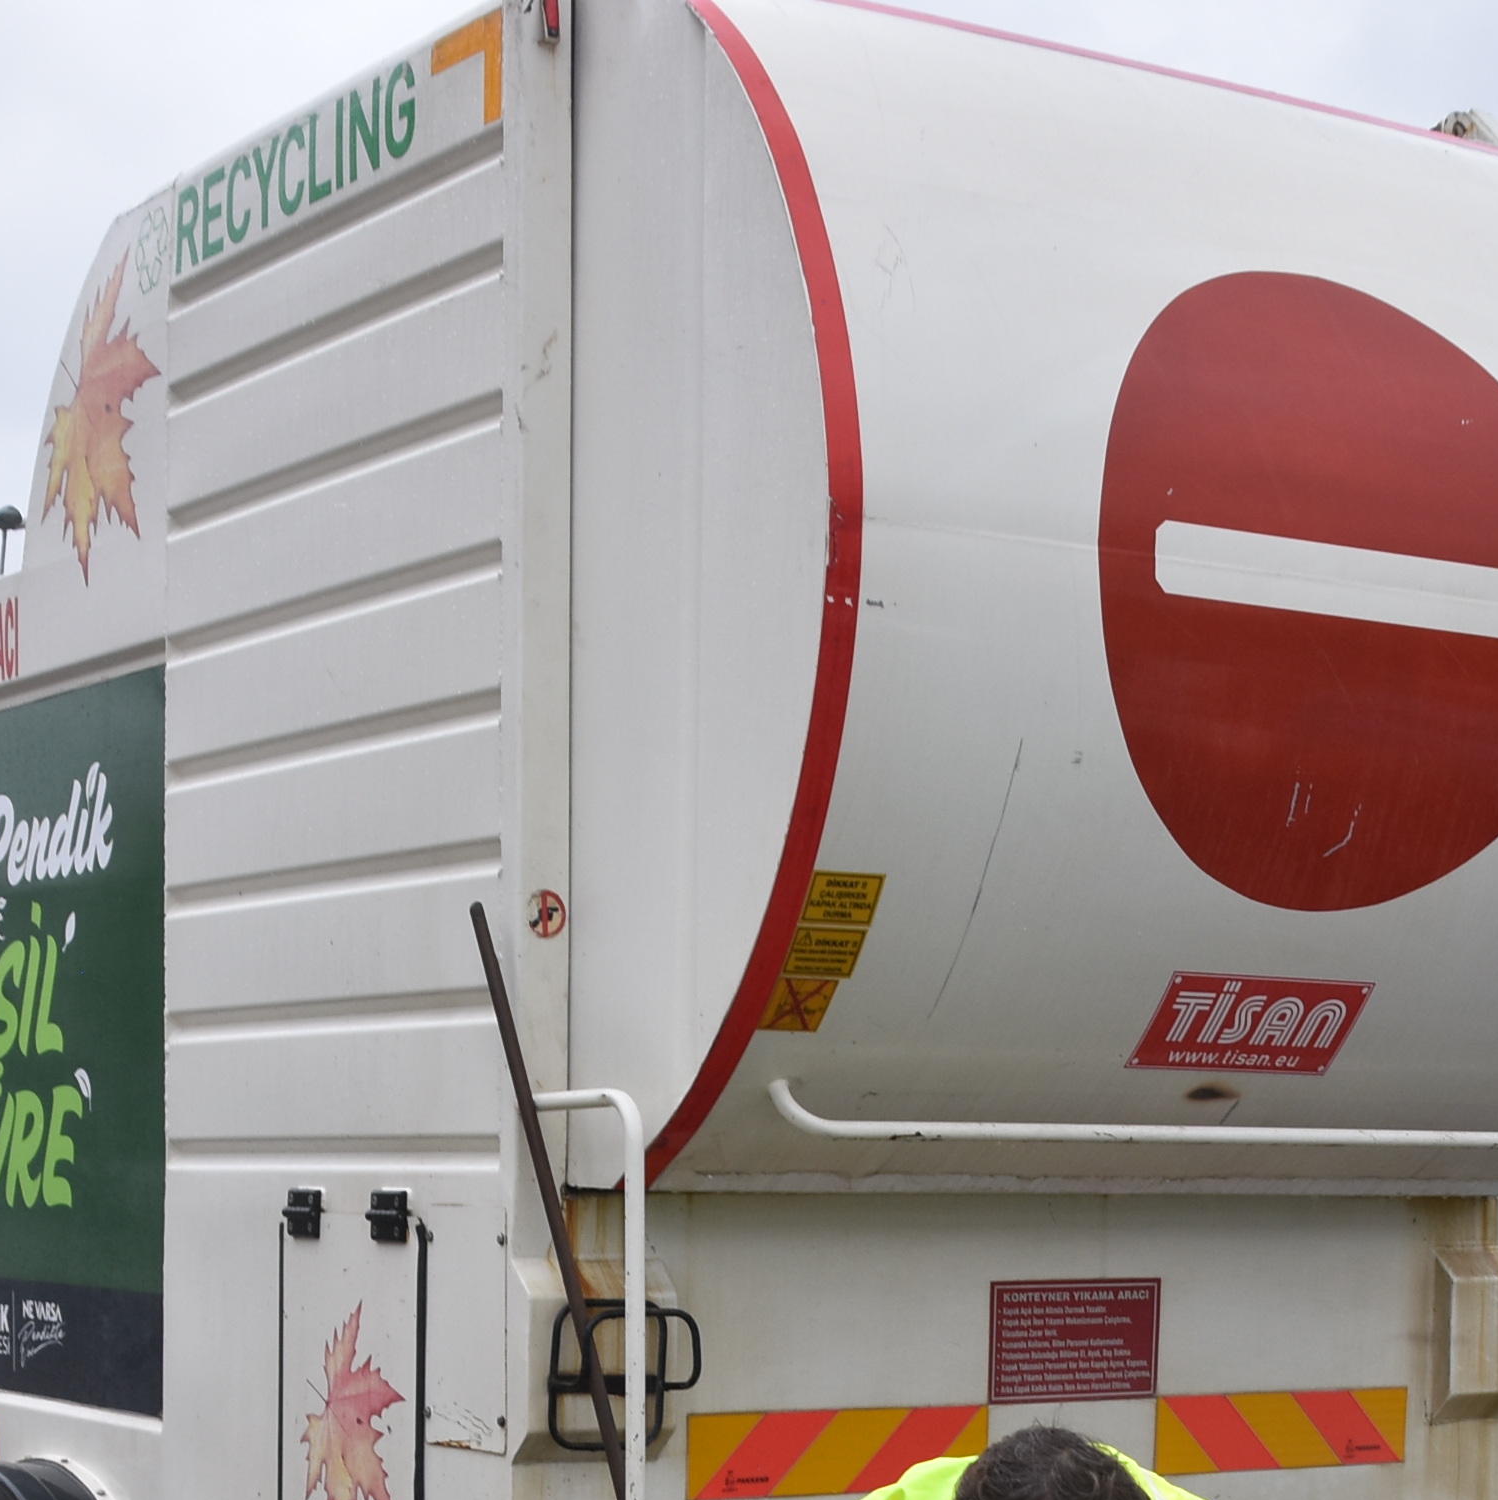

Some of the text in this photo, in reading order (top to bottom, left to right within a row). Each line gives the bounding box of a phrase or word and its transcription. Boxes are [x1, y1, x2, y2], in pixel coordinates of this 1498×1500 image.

[175, 59, 416, 275] RECYCLING
[1165, 980, 1348, 1049] TİSAN
[1167, 1049, 1300, 1068] www.tisan.eu
[1003, 1290, 1150, 1303] KONTEYNER YIKAMA ARACI
